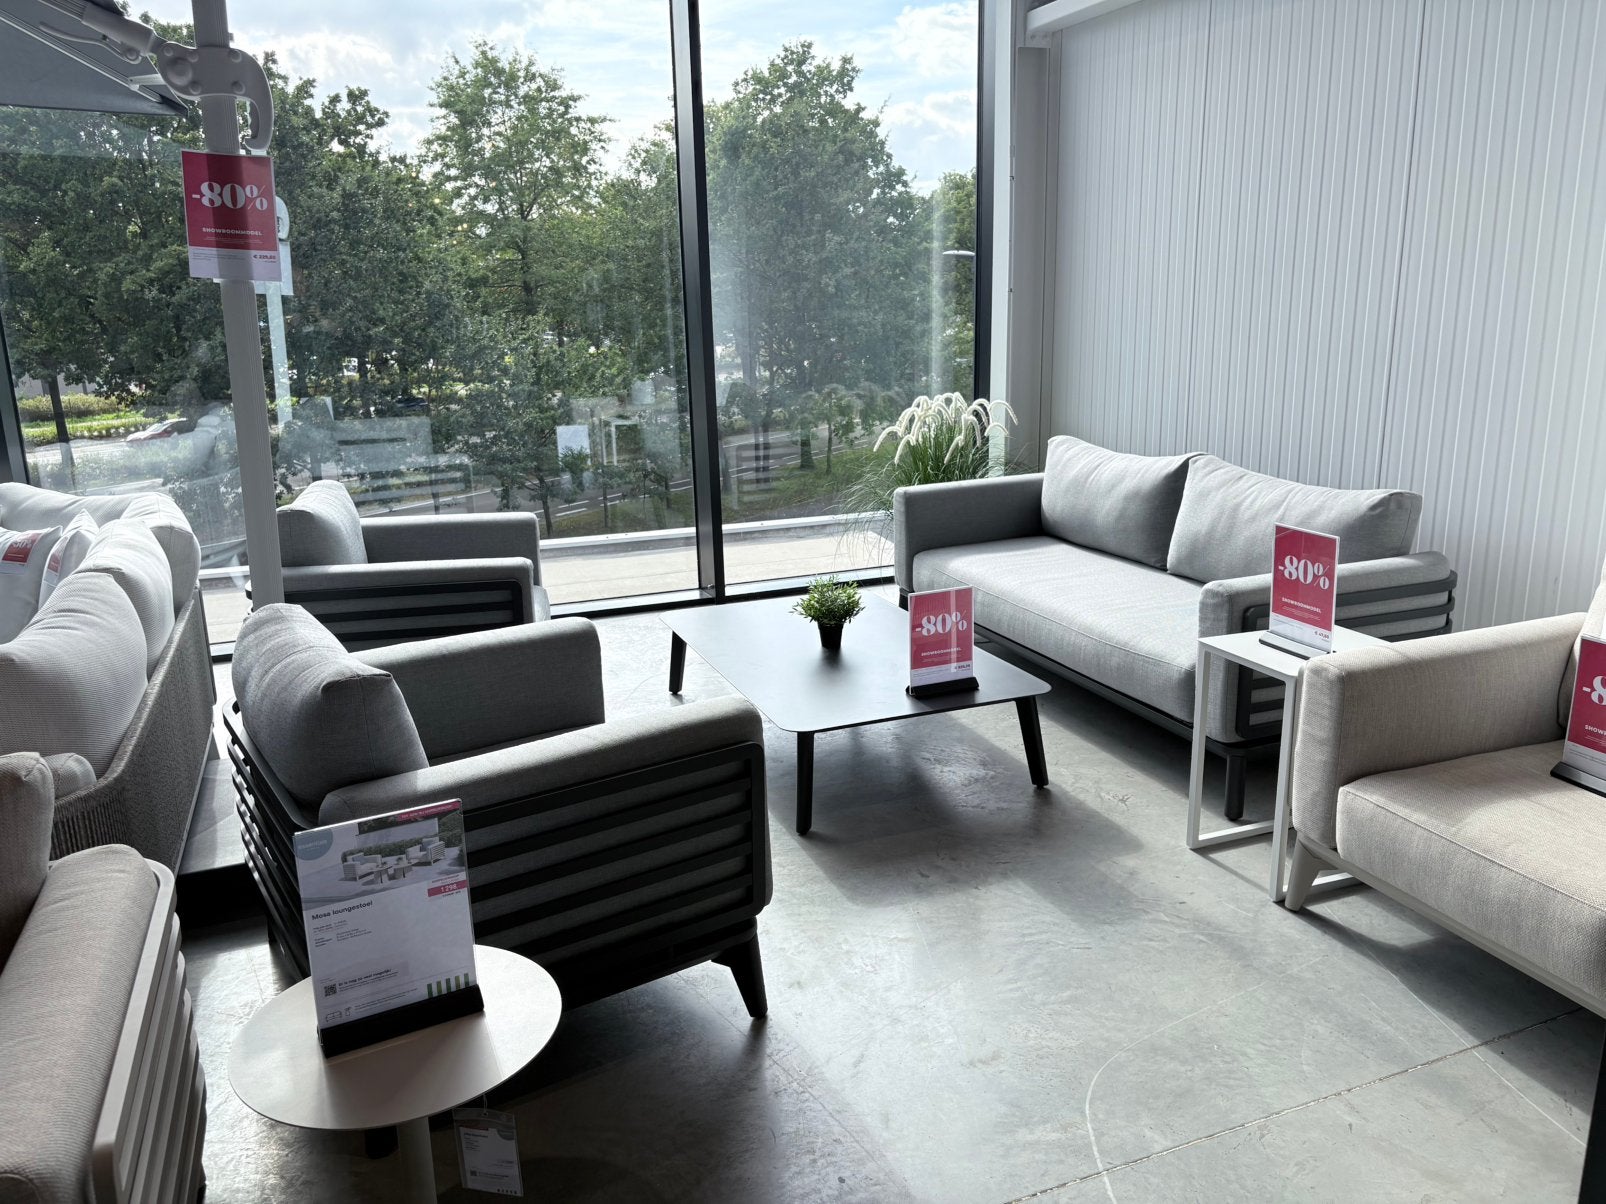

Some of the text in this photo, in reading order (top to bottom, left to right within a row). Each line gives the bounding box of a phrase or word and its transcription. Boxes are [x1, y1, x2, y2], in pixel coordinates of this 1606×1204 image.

[192, 181, 268, 211] -80%
[202, 227, 263, 236] SHOWROOMMODEL
[1278, 555, 1330, 590] -80%
[1282, 597, 1321, 613] SHOWROOMMODEL
[915, 610, 968, 636] -80%
[311, 900, 373, 920] Mosa loungestoel
